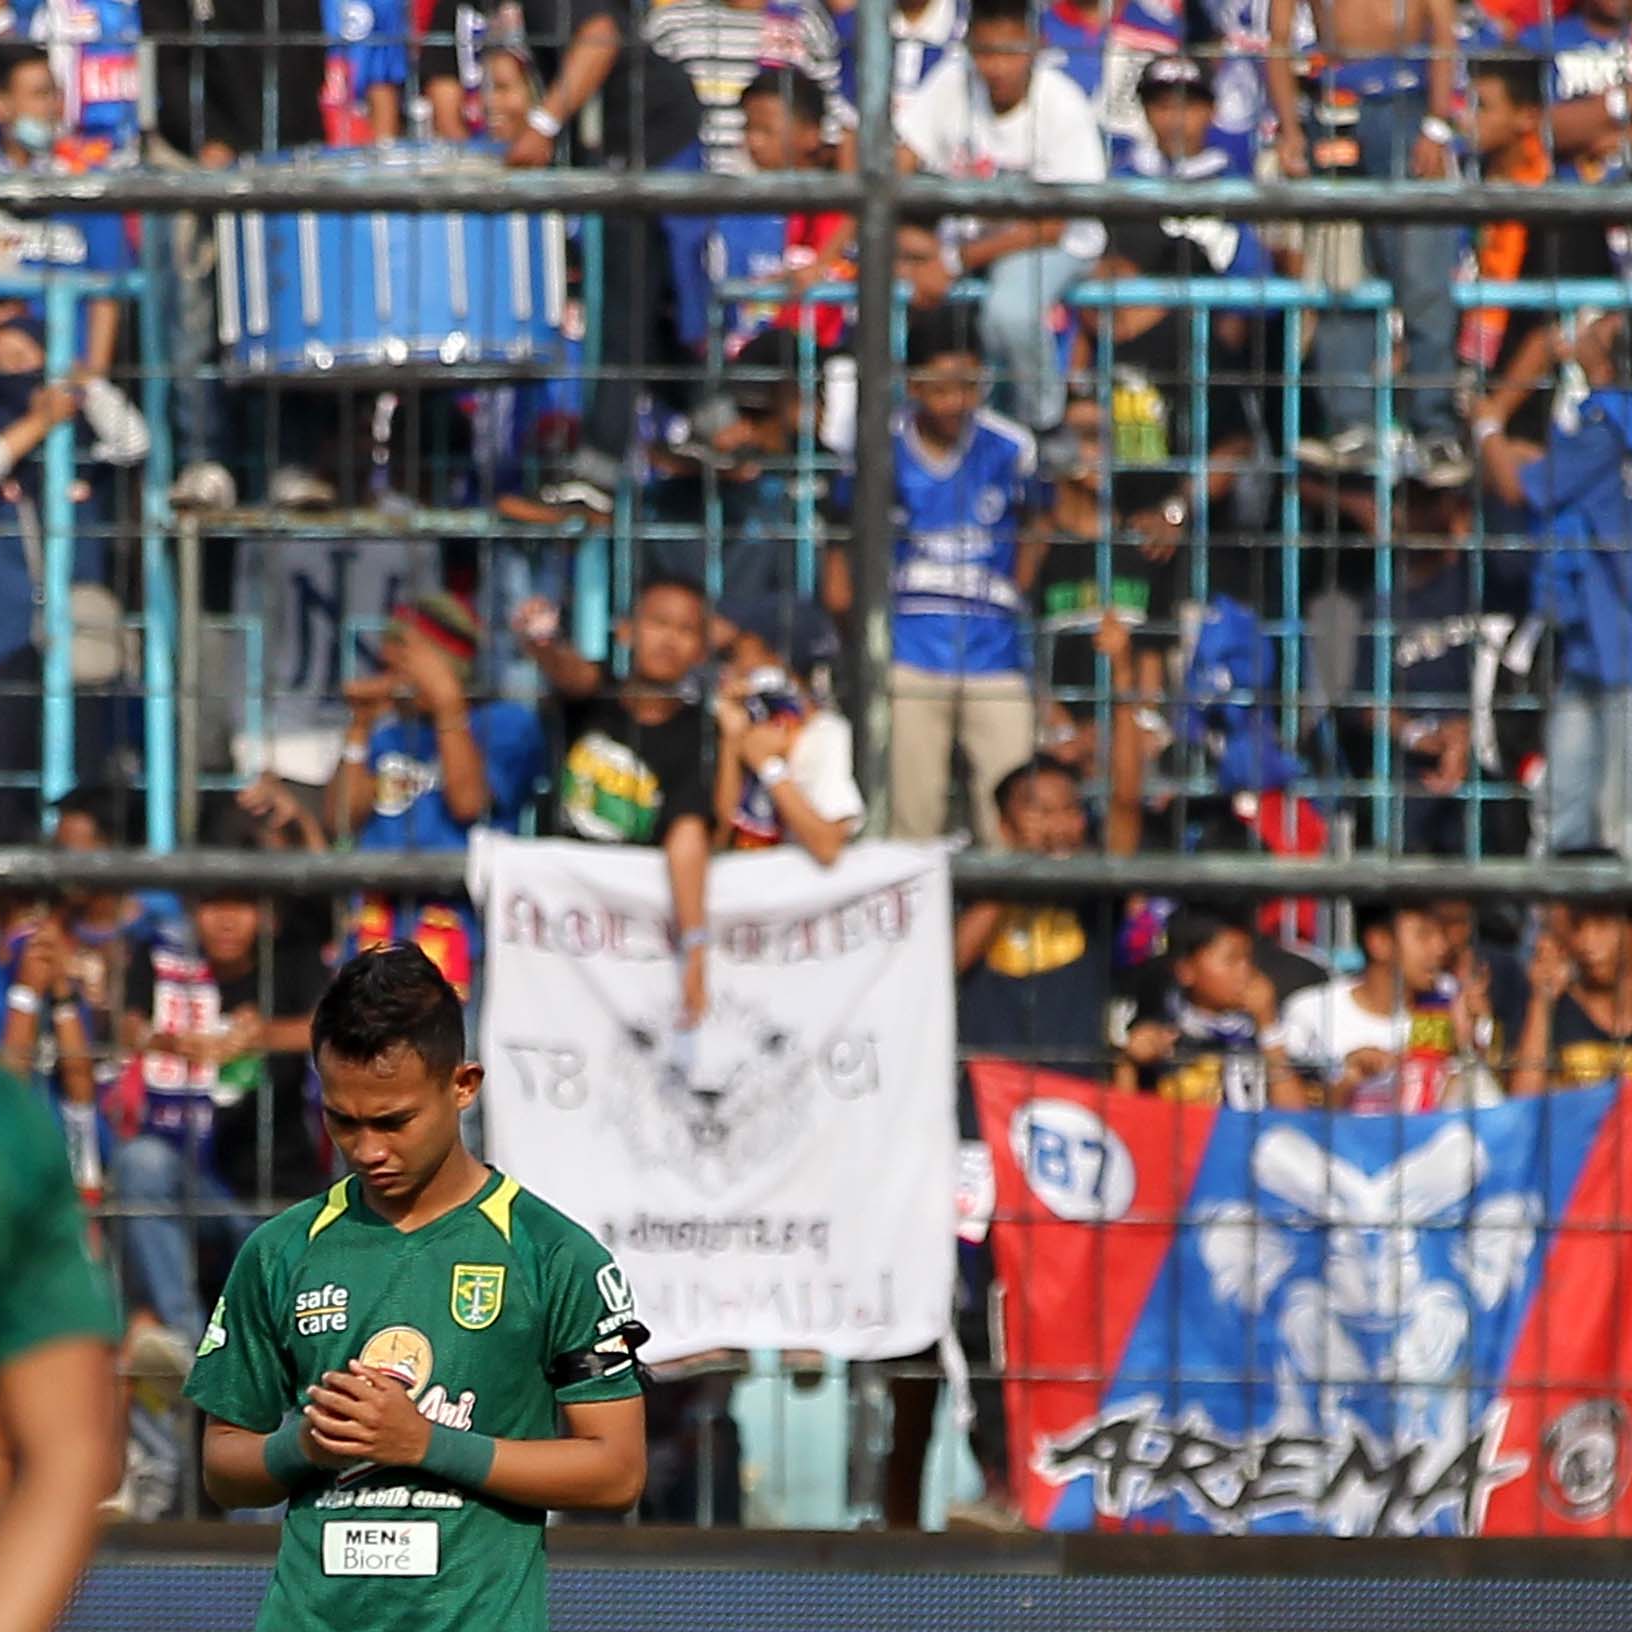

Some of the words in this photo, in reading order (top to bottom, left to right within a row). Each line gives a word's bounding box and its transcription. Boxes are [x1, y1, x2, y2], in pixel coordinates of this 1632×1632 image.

[296, 1284, 349, 1311] safe
[297, 1310, 348, 1336] care
[1033, 1395, 1528, 1535] AREMA
[343, 1546, 412, 1570] Bioré
